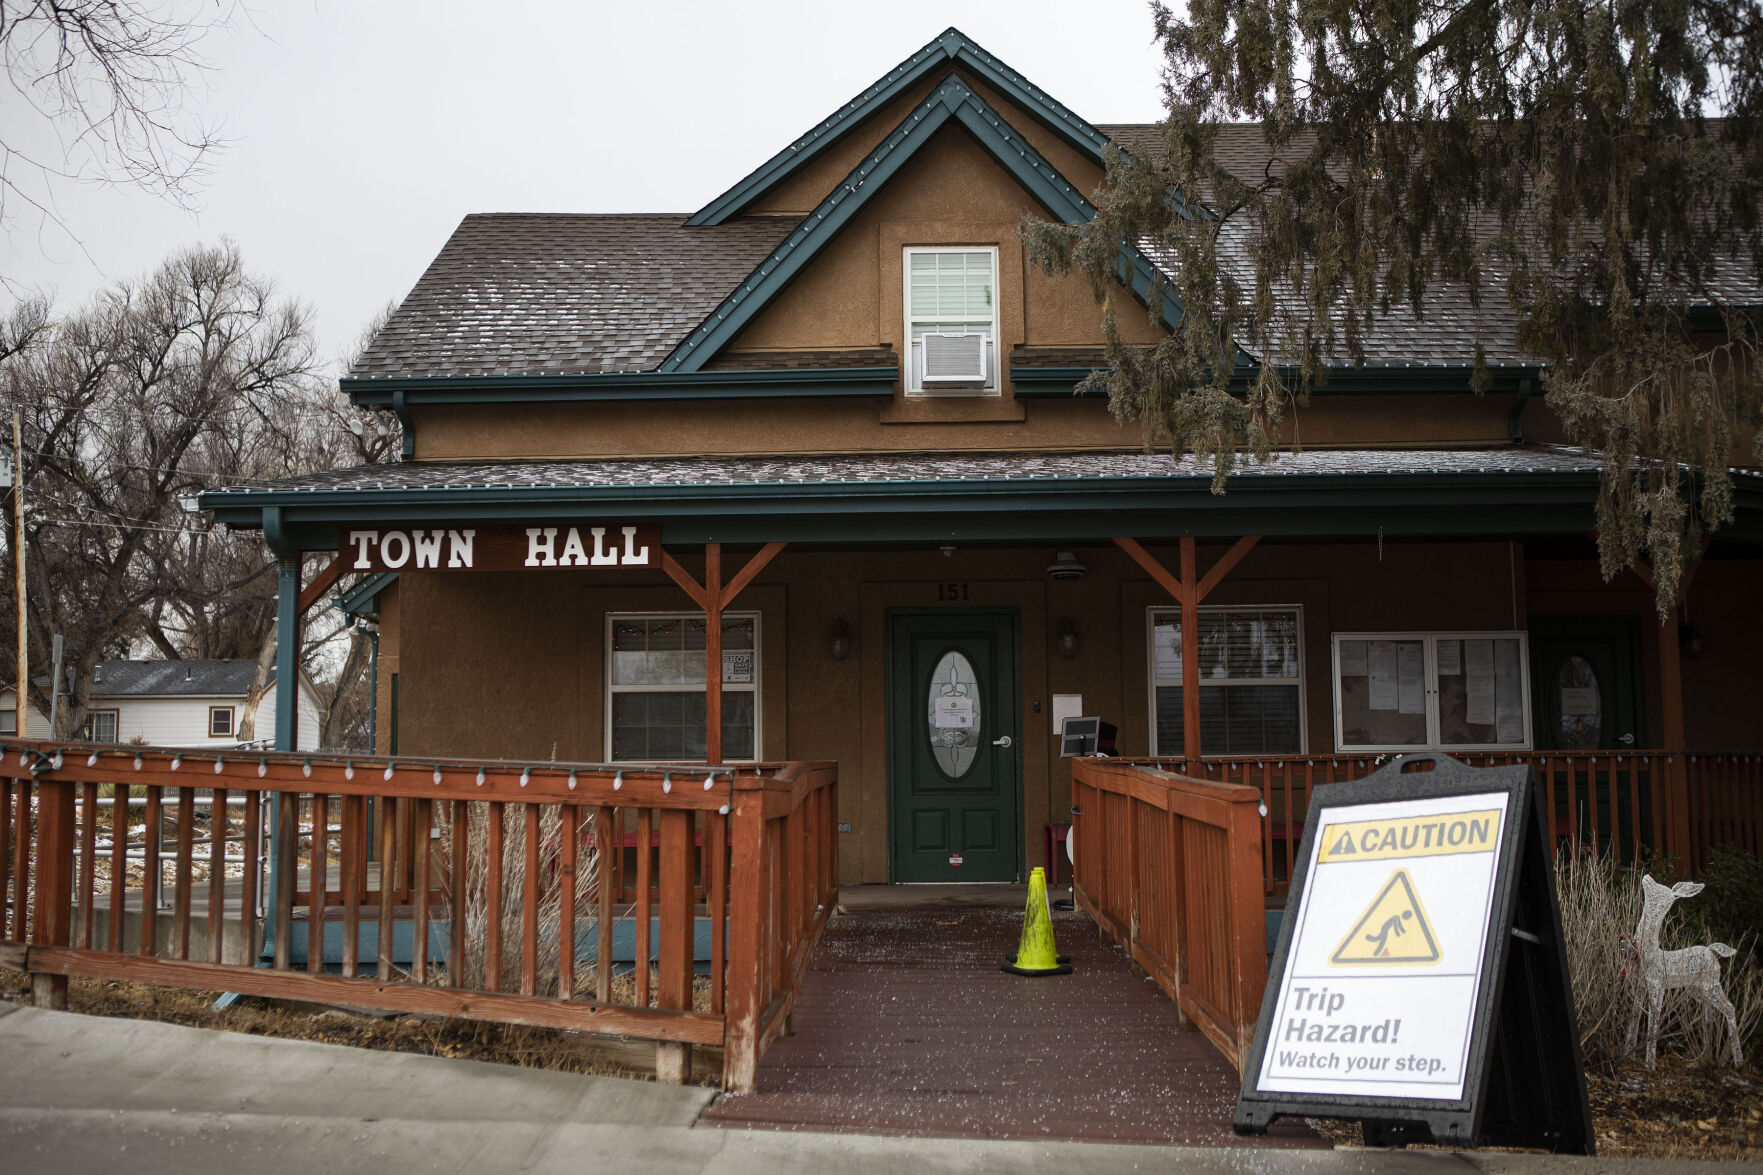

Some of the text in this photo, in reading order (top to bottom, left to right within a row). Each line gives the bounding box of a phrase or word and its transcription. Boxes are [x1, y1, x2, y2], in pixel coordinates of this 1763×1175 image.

[350, 526, 649, 569] TOWN HALL
[937, 583, 969, 601] 151
[724, 656, 749, 664] SHOP
[1360, 818, 1490, 853] CAUTION
[1294, 987, 1345, 1017] Trip
[1284, 1018, 1402, 1044] Hazard!
[1279, 1050, 1447, 1076] Watch your step.
